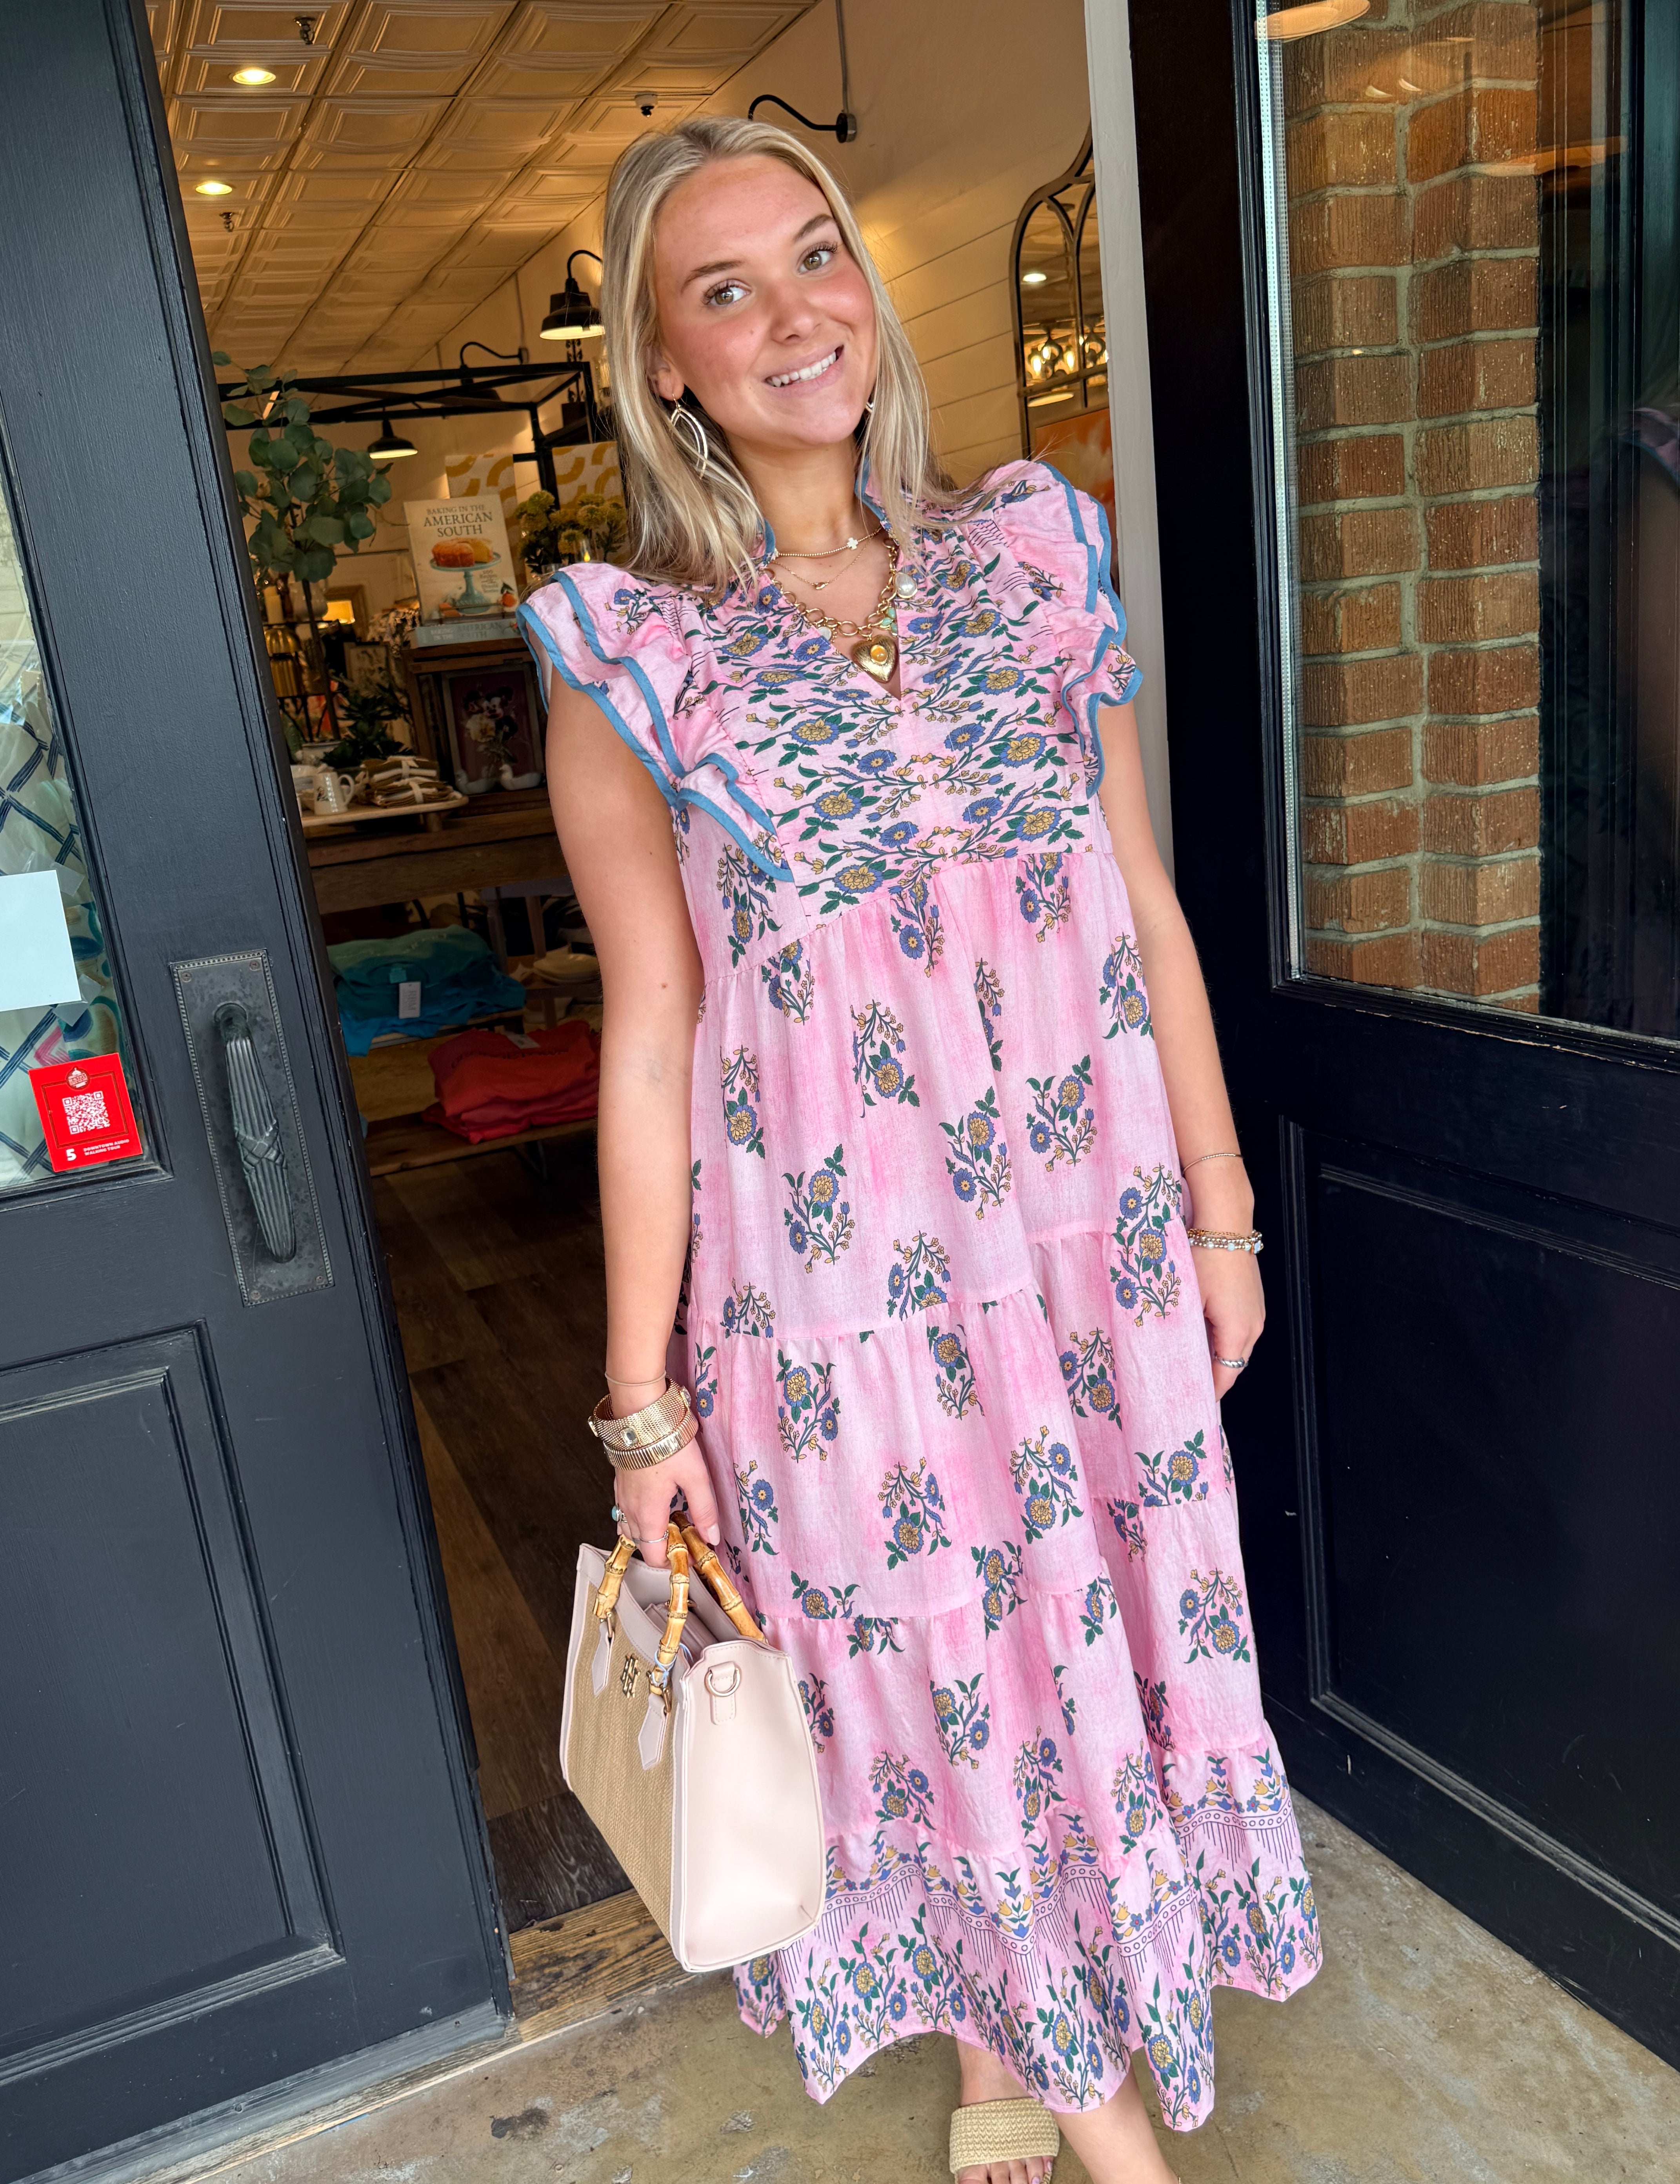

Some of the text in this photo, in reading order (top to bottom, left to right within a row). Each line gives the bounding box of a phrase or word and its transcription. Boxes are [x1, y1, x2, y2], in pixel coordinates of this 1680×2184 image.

[424, 512, 493, 526] AMERICAN
[437, 524, 482, 537] SOUTH
[84, 1142, 113, 1152] DOWNTOWN
[66, 1148, 76, 1161] 5
